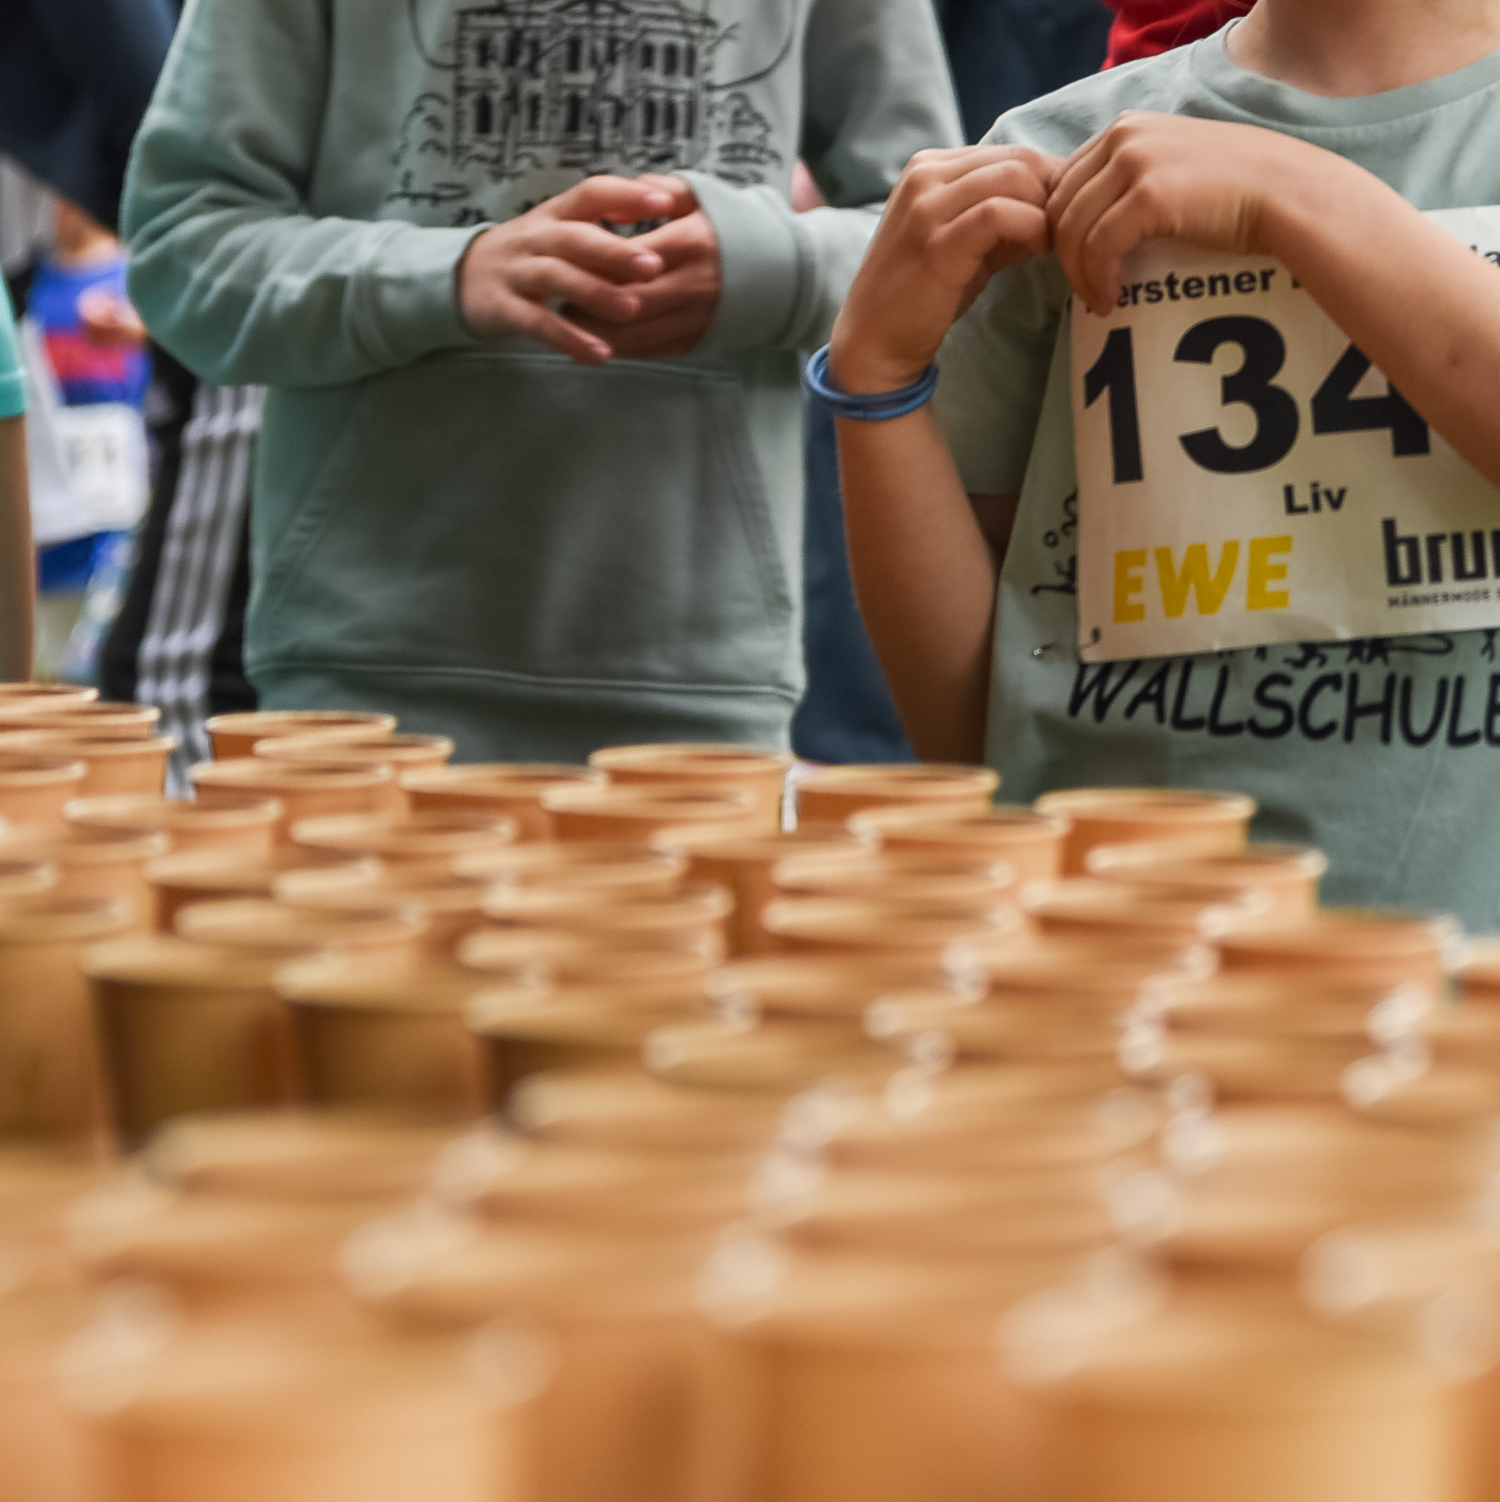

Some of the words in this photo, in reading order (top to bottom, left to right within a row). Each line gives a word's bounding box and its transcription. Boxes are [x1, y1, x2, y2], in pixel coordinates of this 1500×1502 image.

[1086, 268, 1276, 313] erstener
[1082, 314, 1431, 484] 134
[1283, 483, 1348, 516] Liv
[1112, 535, 1293, 623] EWE
